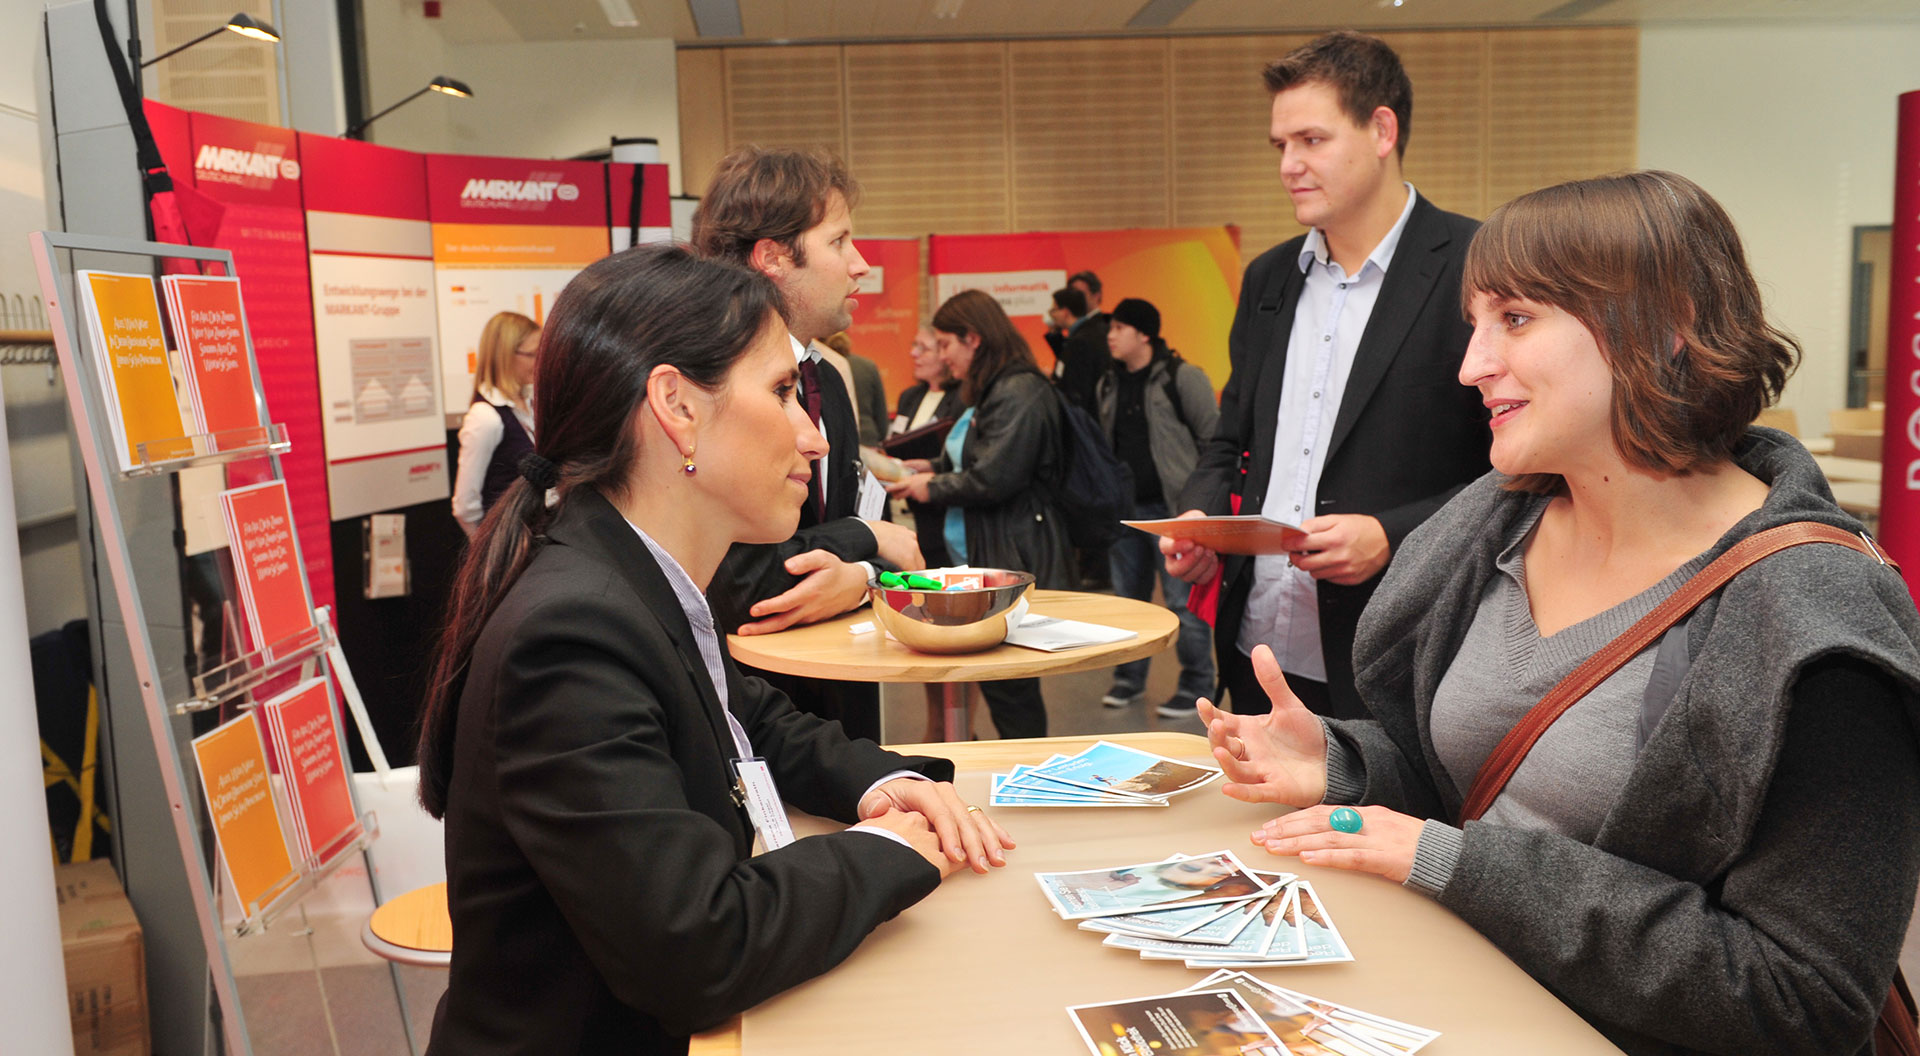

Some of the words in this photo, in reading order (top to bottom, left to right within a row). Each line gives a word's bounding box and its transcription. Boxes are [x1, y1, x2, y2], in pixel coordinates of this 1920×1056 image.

[195, 144, 279, 179] MARKANT
[461, 178, 558, 201] MARKANT
[994, 281, 1049, 293] informatik
